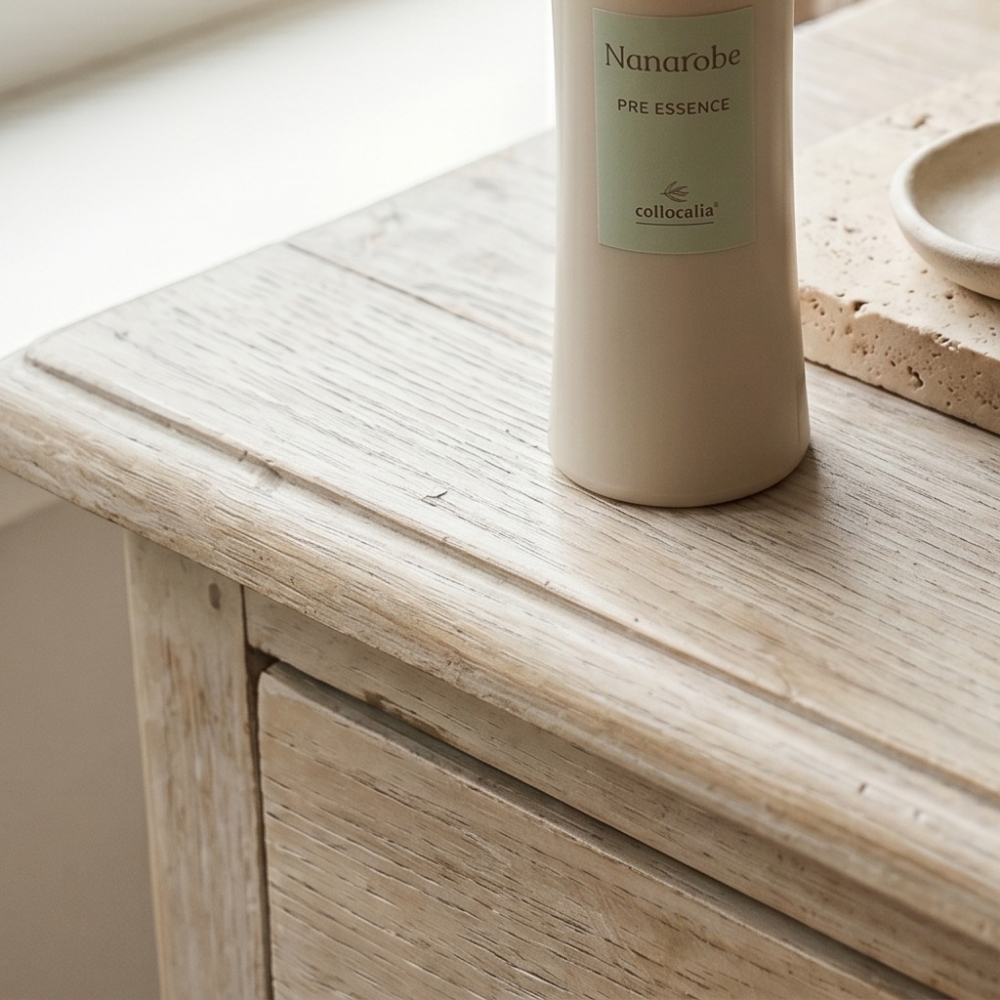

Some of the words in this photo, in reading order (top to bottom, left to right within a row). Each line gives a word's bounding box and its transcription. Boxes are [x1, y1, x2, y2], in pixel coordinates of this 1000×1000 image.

[604, 42, 742, 73] Nanarobe
[617, 98, 649, 115] PRE
[655, 97, 731, 116] ESSENCE
